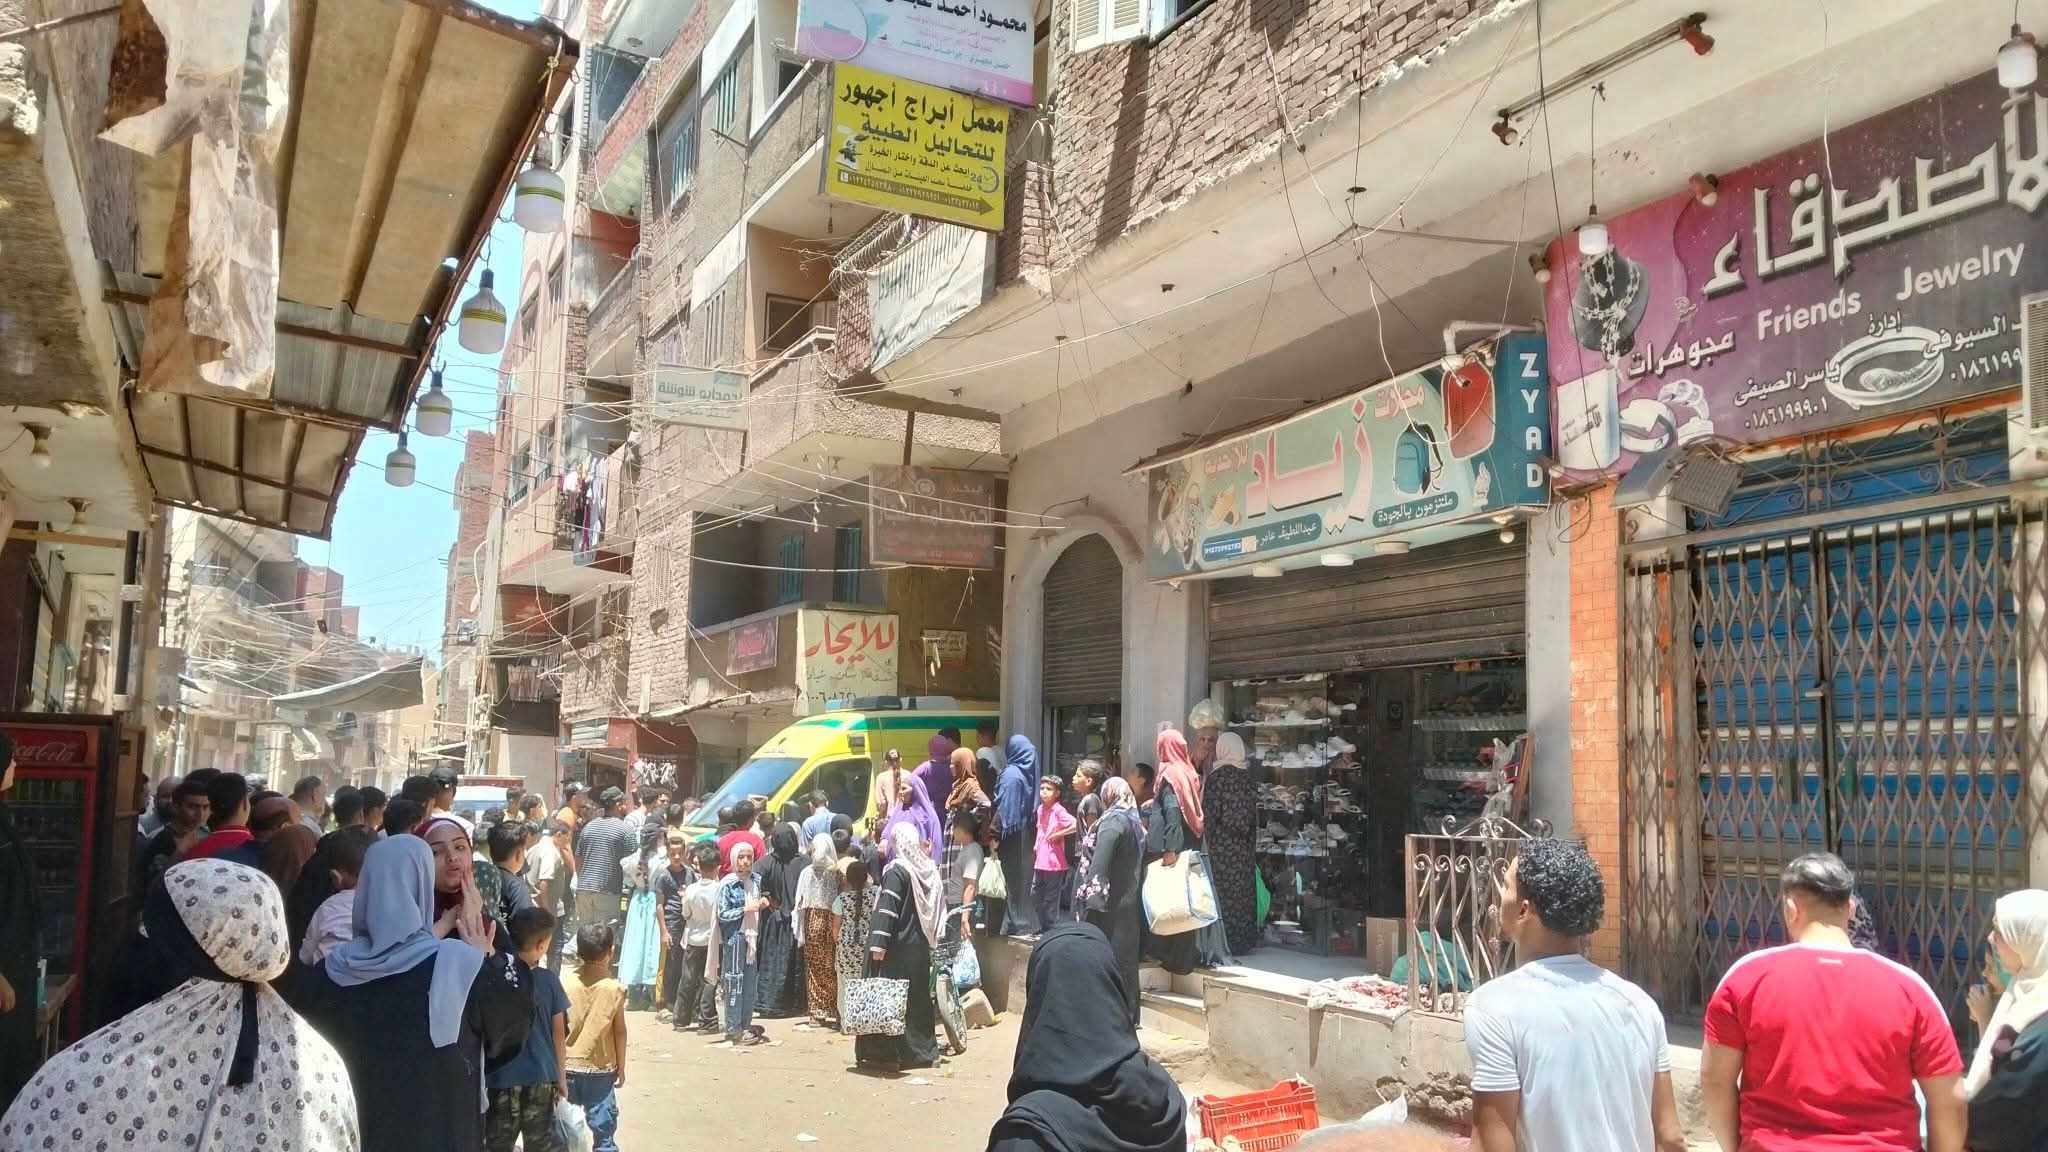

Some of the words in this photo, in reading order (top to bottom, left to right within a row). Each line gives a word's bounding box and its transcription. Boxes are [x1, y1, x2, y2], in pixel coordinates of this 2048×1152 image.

[979, 9, 1027, 32] محمود
[839, 81, 897, 112] أجهور
[904, 95, 955, 130] أبراج
[861, 112, 918, 144] الطبية
[962, 100, 1004, 134] معمل
[924, 133, 995, 162] للتحاليل
[1702, 91, 2048, 300] لأصدقاء
[1756, 288, 1862, 341] Friends
[1896, 242, 2025, 301] Jewelry
[1627, 329, 1736, 379] مجوهرات
[1798, 360, 1841, 391] ياسر
[1519, 352, 1544, 489] ZYAD
[1246, 396, 1373, 537] زياد
